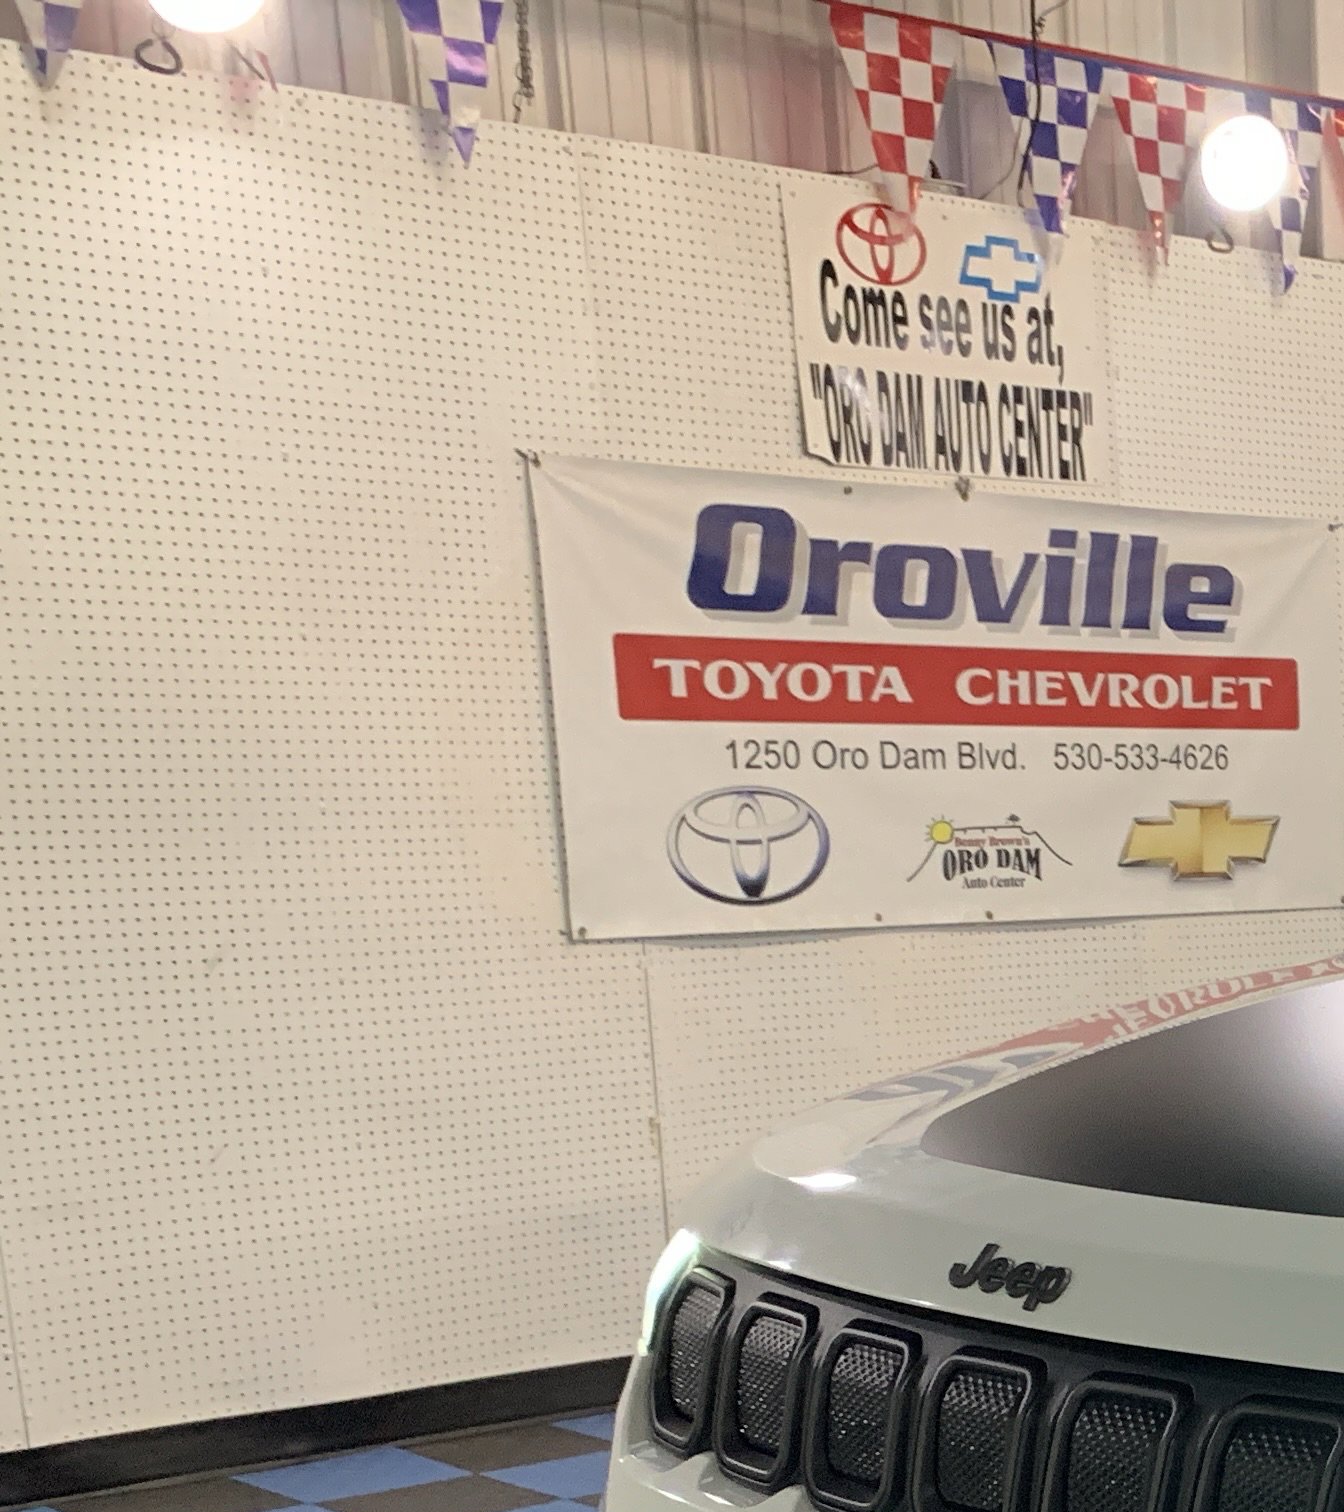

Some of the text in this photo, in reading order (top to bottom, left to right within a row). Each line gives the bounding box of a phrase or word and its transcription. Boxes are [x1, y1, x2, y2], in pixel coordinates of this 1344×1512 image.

[819, 258, 1065, 386] Come see us at,
[876, 370, 927, 469] DAM
[934, 376, 991, 475] AUTO
[998, 382, 1093, 482] CENTER"
[686, 503, 1236, 636] Oroville
[653, 658, 1273, 711] TOYOTA CHEVROLET
[726, 740, 1230, 772] 1250 Oro Dam Blvd. 530-533-4626
[942, 848, 1042, 881] ORO DAM
[962, 876, 1025, 889] Auto Center
[948, 1243, 1072, 1312] Jeep
